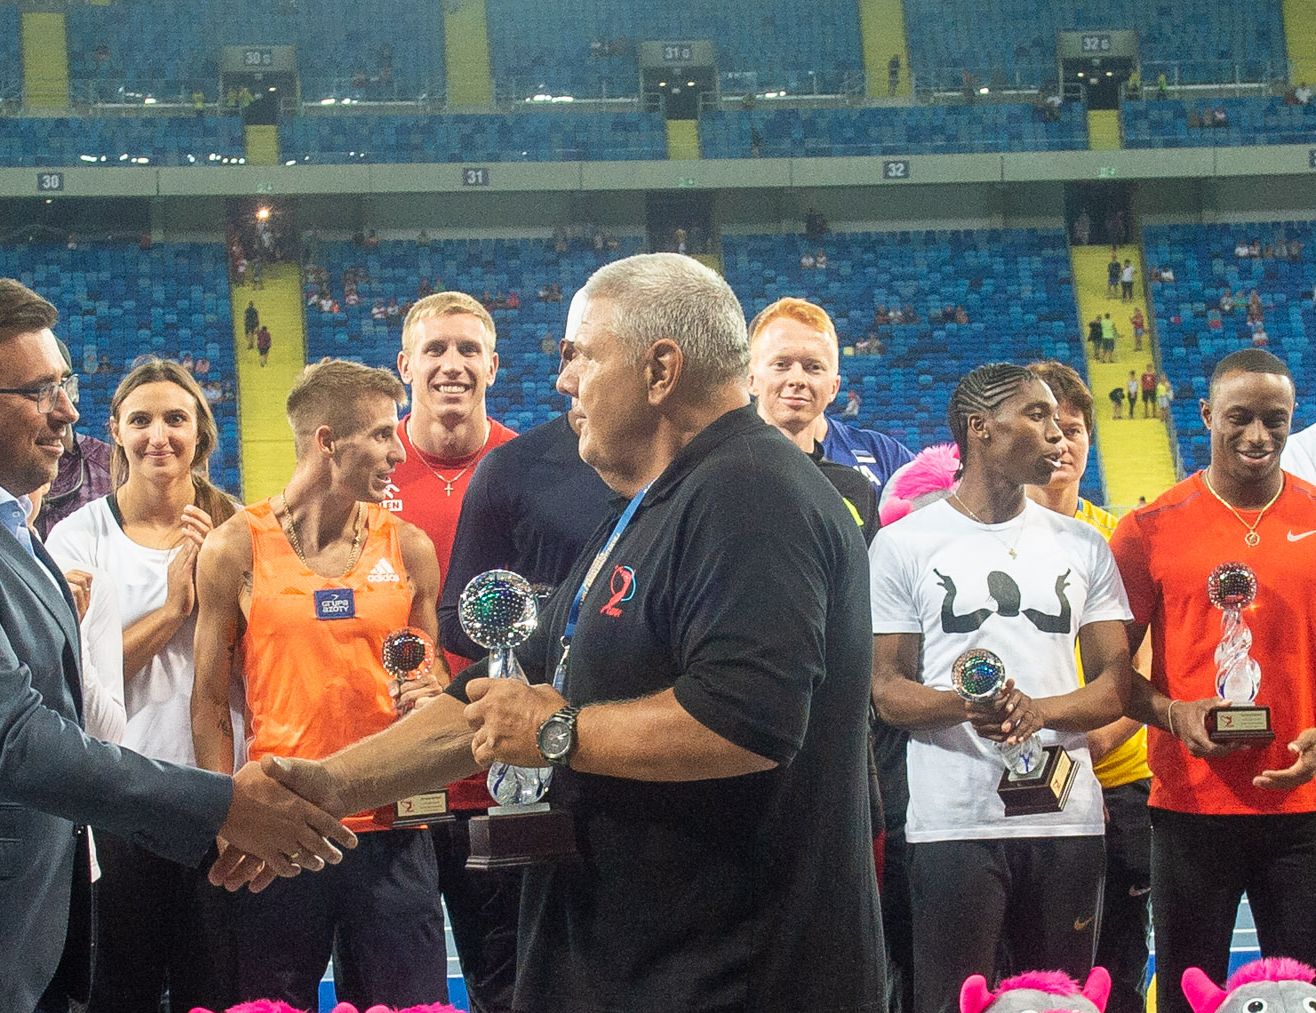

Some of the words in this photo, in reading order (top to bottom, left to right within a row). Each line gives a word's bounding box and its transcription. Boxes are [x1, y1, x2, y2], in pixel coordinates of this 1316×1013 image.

[1083, 37, 1099, 50] 32
[665, 47, 679, 60] 31
[887, 162, 904, 177] 32
[41, 175, 58, 188] 30
[466, 170, 482, 184] 31
[367, 574, 399, 583] adidas
